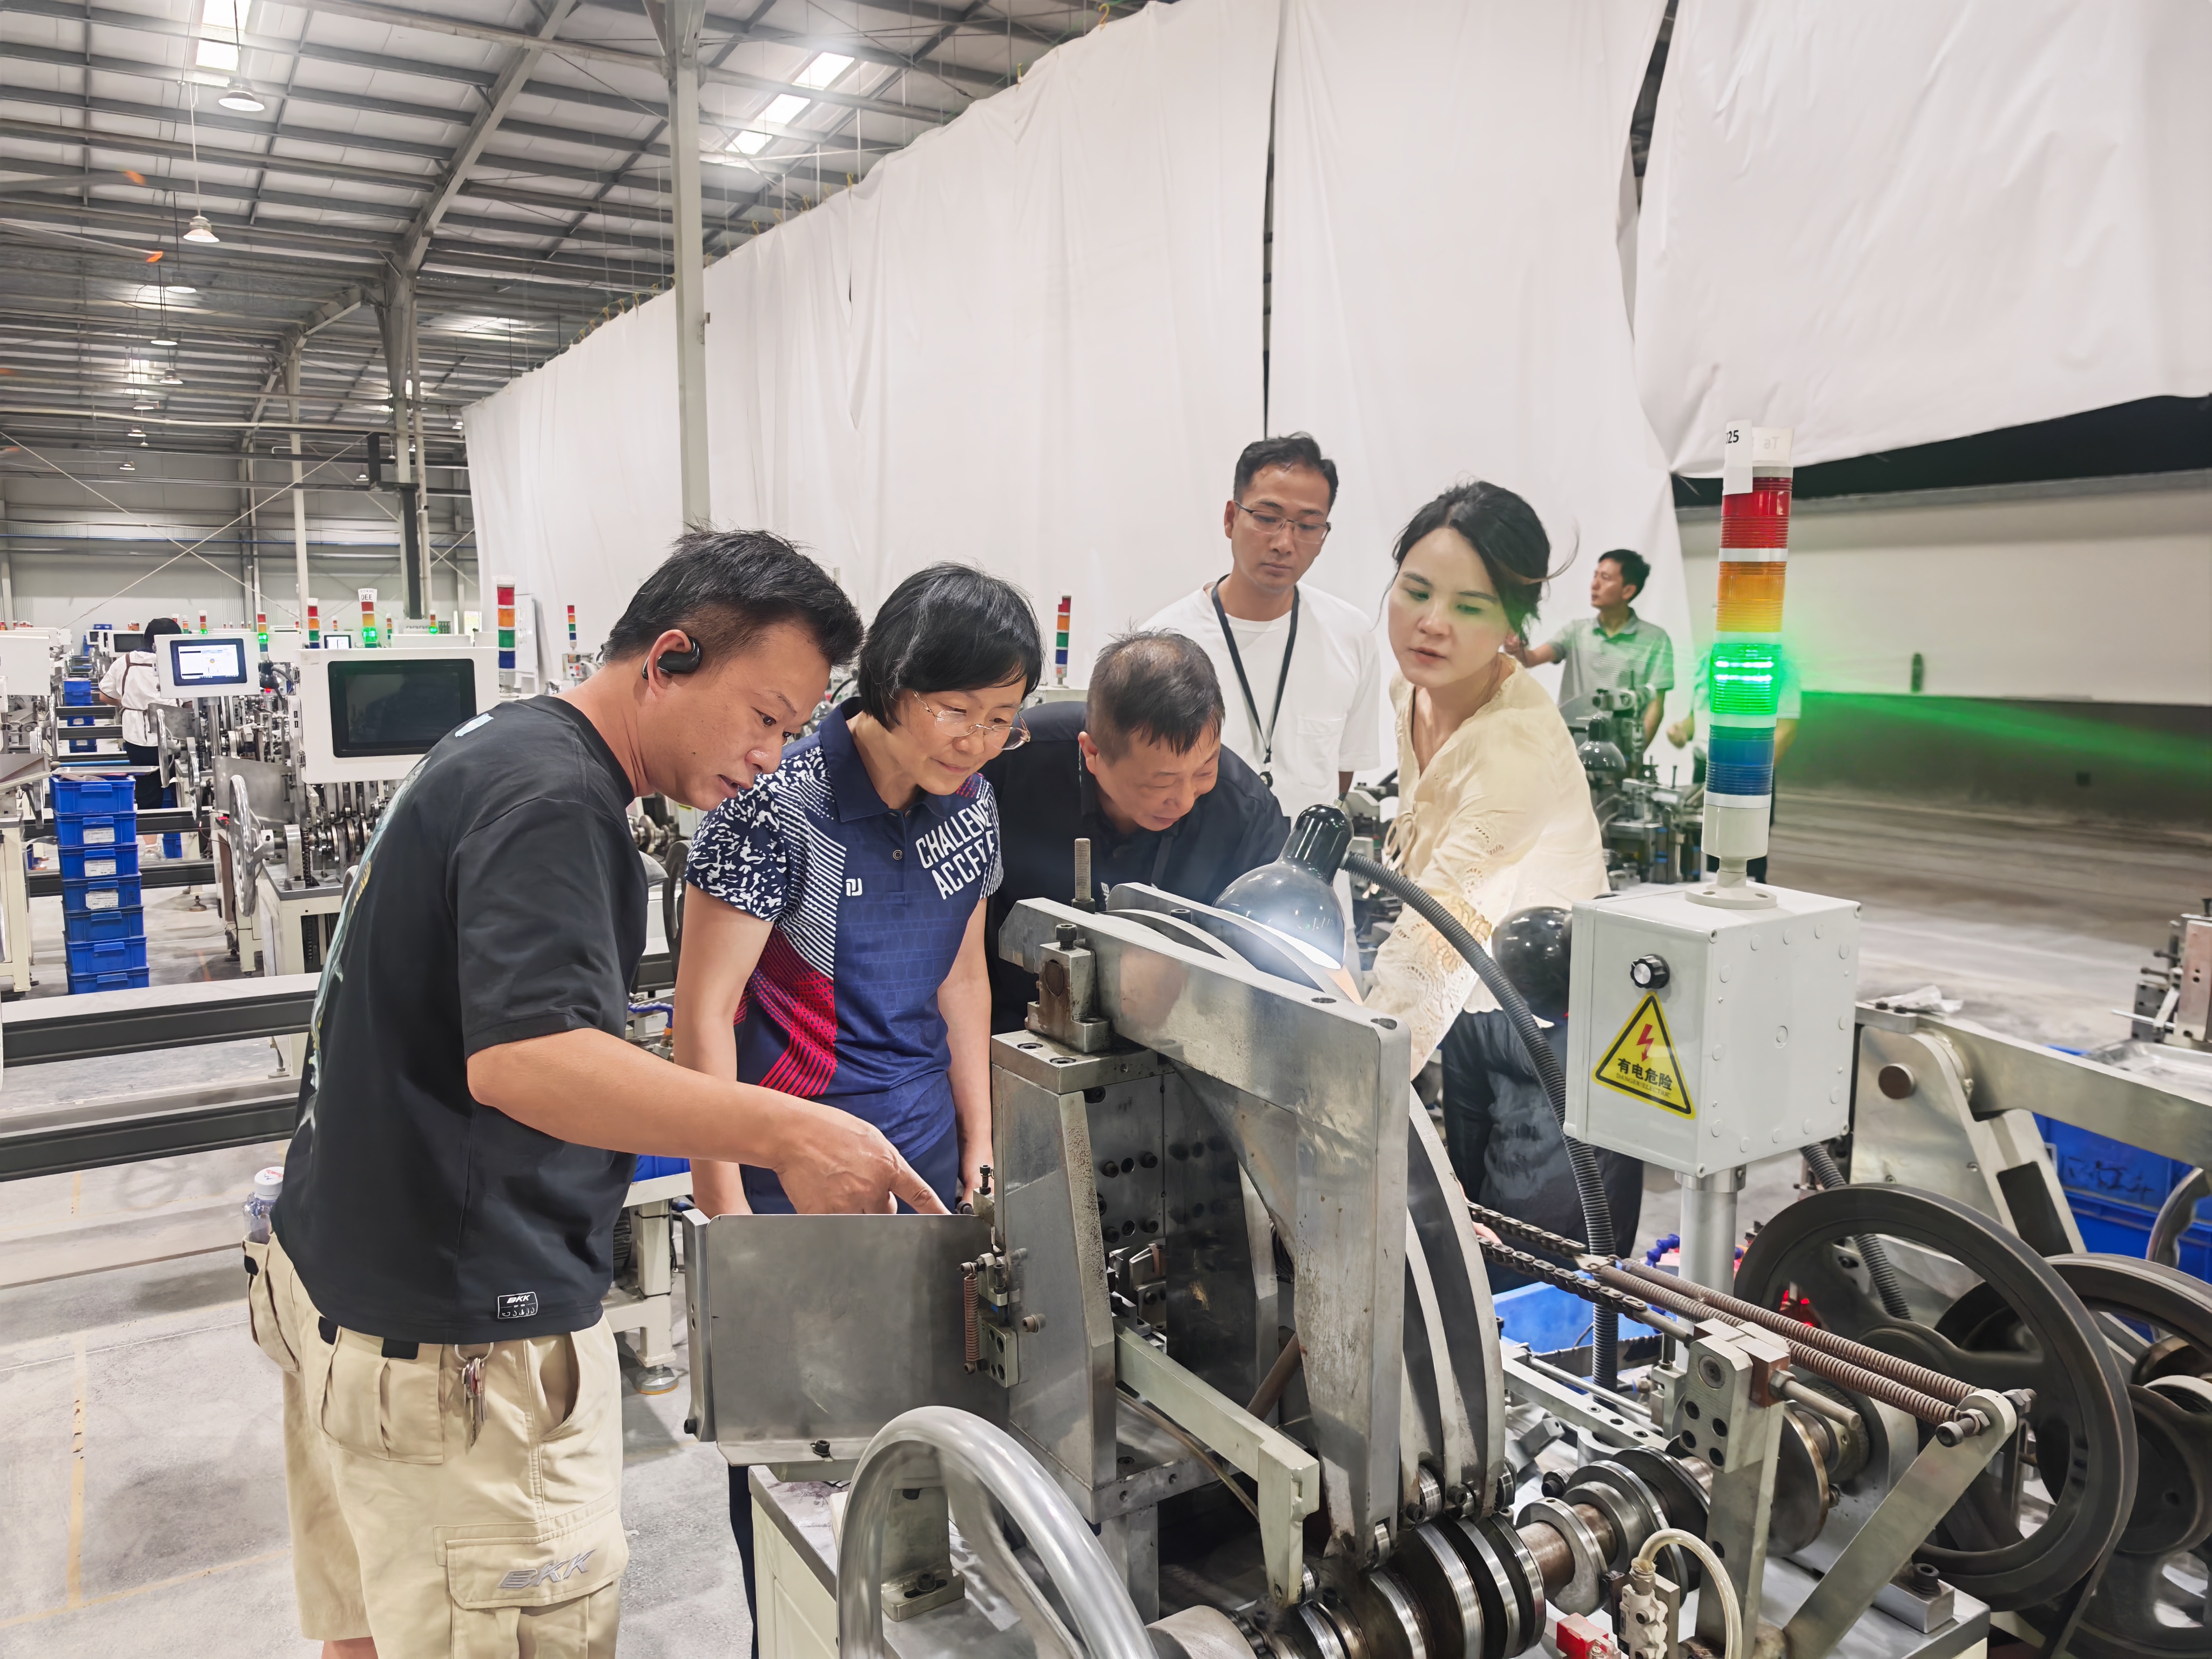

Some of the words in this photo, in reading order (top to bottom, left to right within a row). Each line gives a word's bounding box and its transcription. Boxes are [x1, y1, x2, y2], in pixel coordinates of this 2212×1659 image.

[1617, 1058, 1673, 1091] 有电危险
[507, 1294, 531, 1304] BKK
[497, 1548, 597, 1589] BKK
